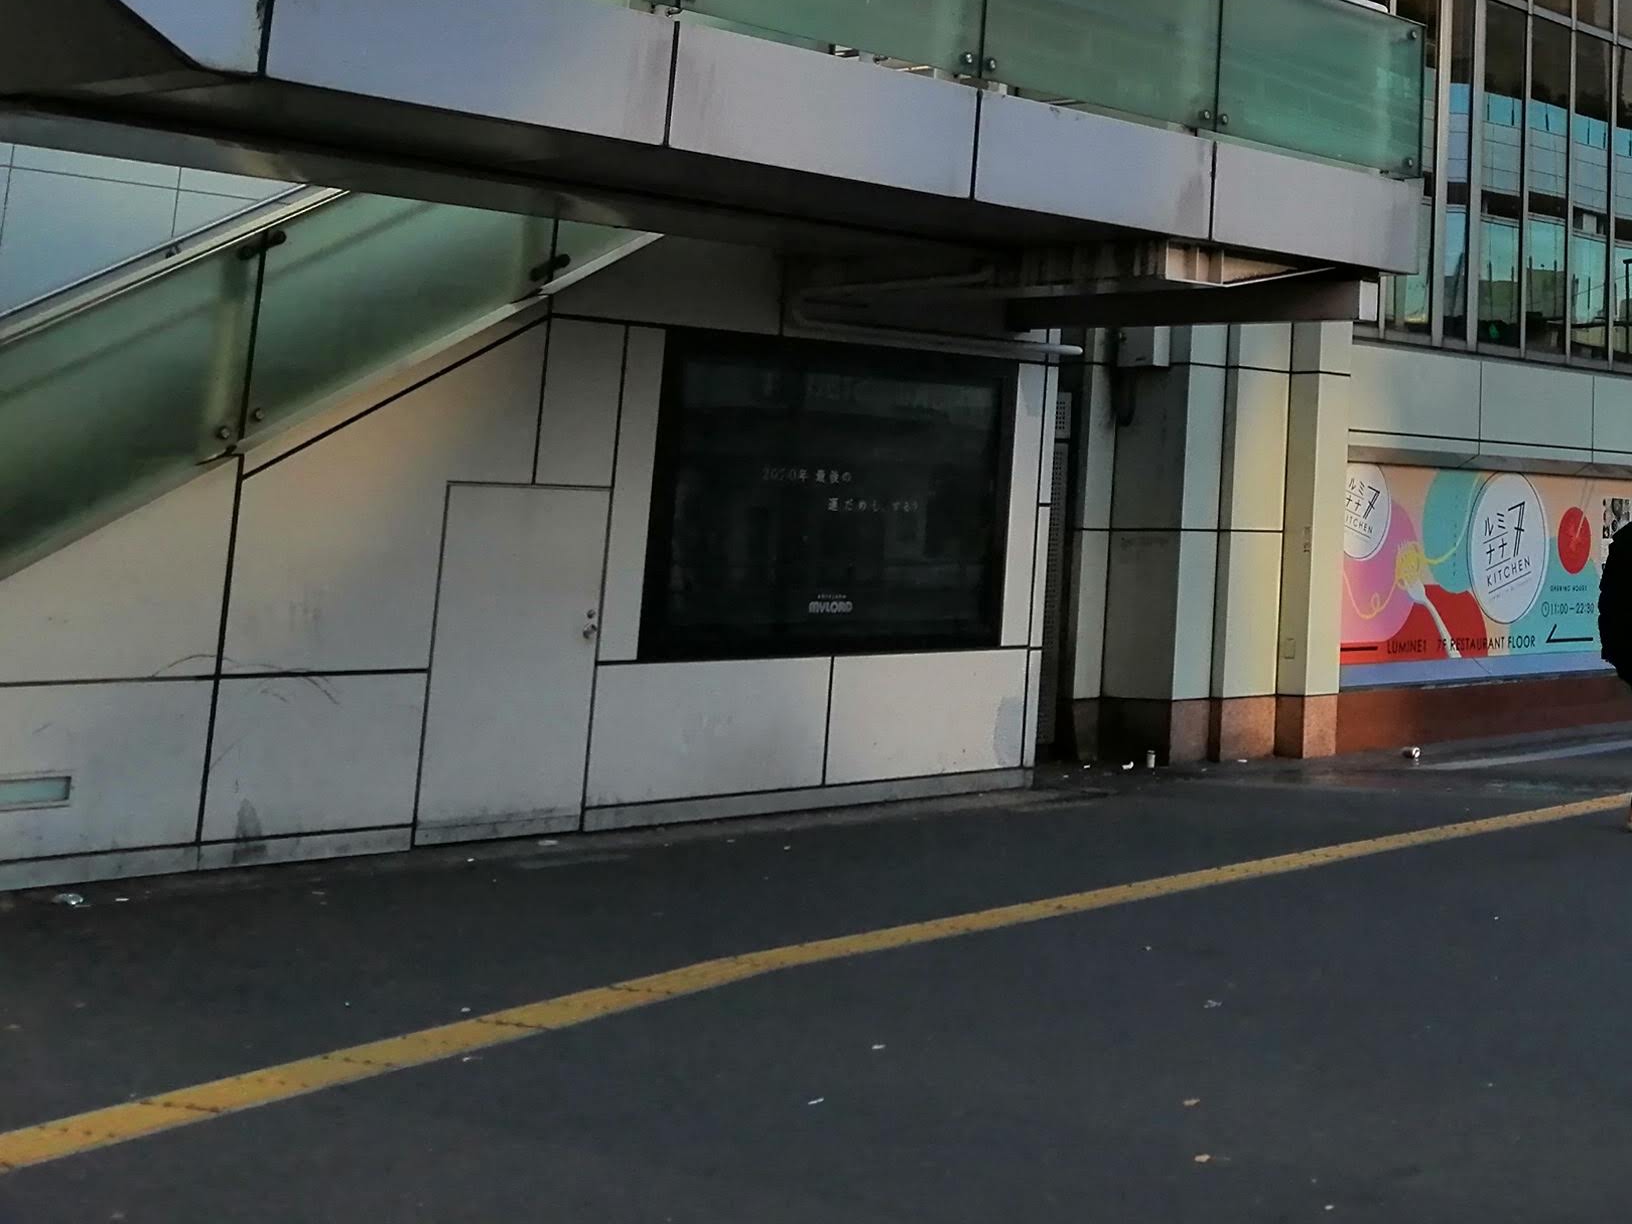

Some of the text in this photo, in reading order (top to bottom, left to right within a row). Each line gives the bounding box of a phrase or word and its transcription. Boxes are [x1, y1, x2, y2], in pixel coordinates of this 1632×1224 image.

[1345, 514, 1374, 534] ITCHEN
[1486, 556, 1532, 587] KITCHEN
[1450, 636, 1506, 652] RESTAURANT
[1508, 634, 1536, 649] FLOOR
